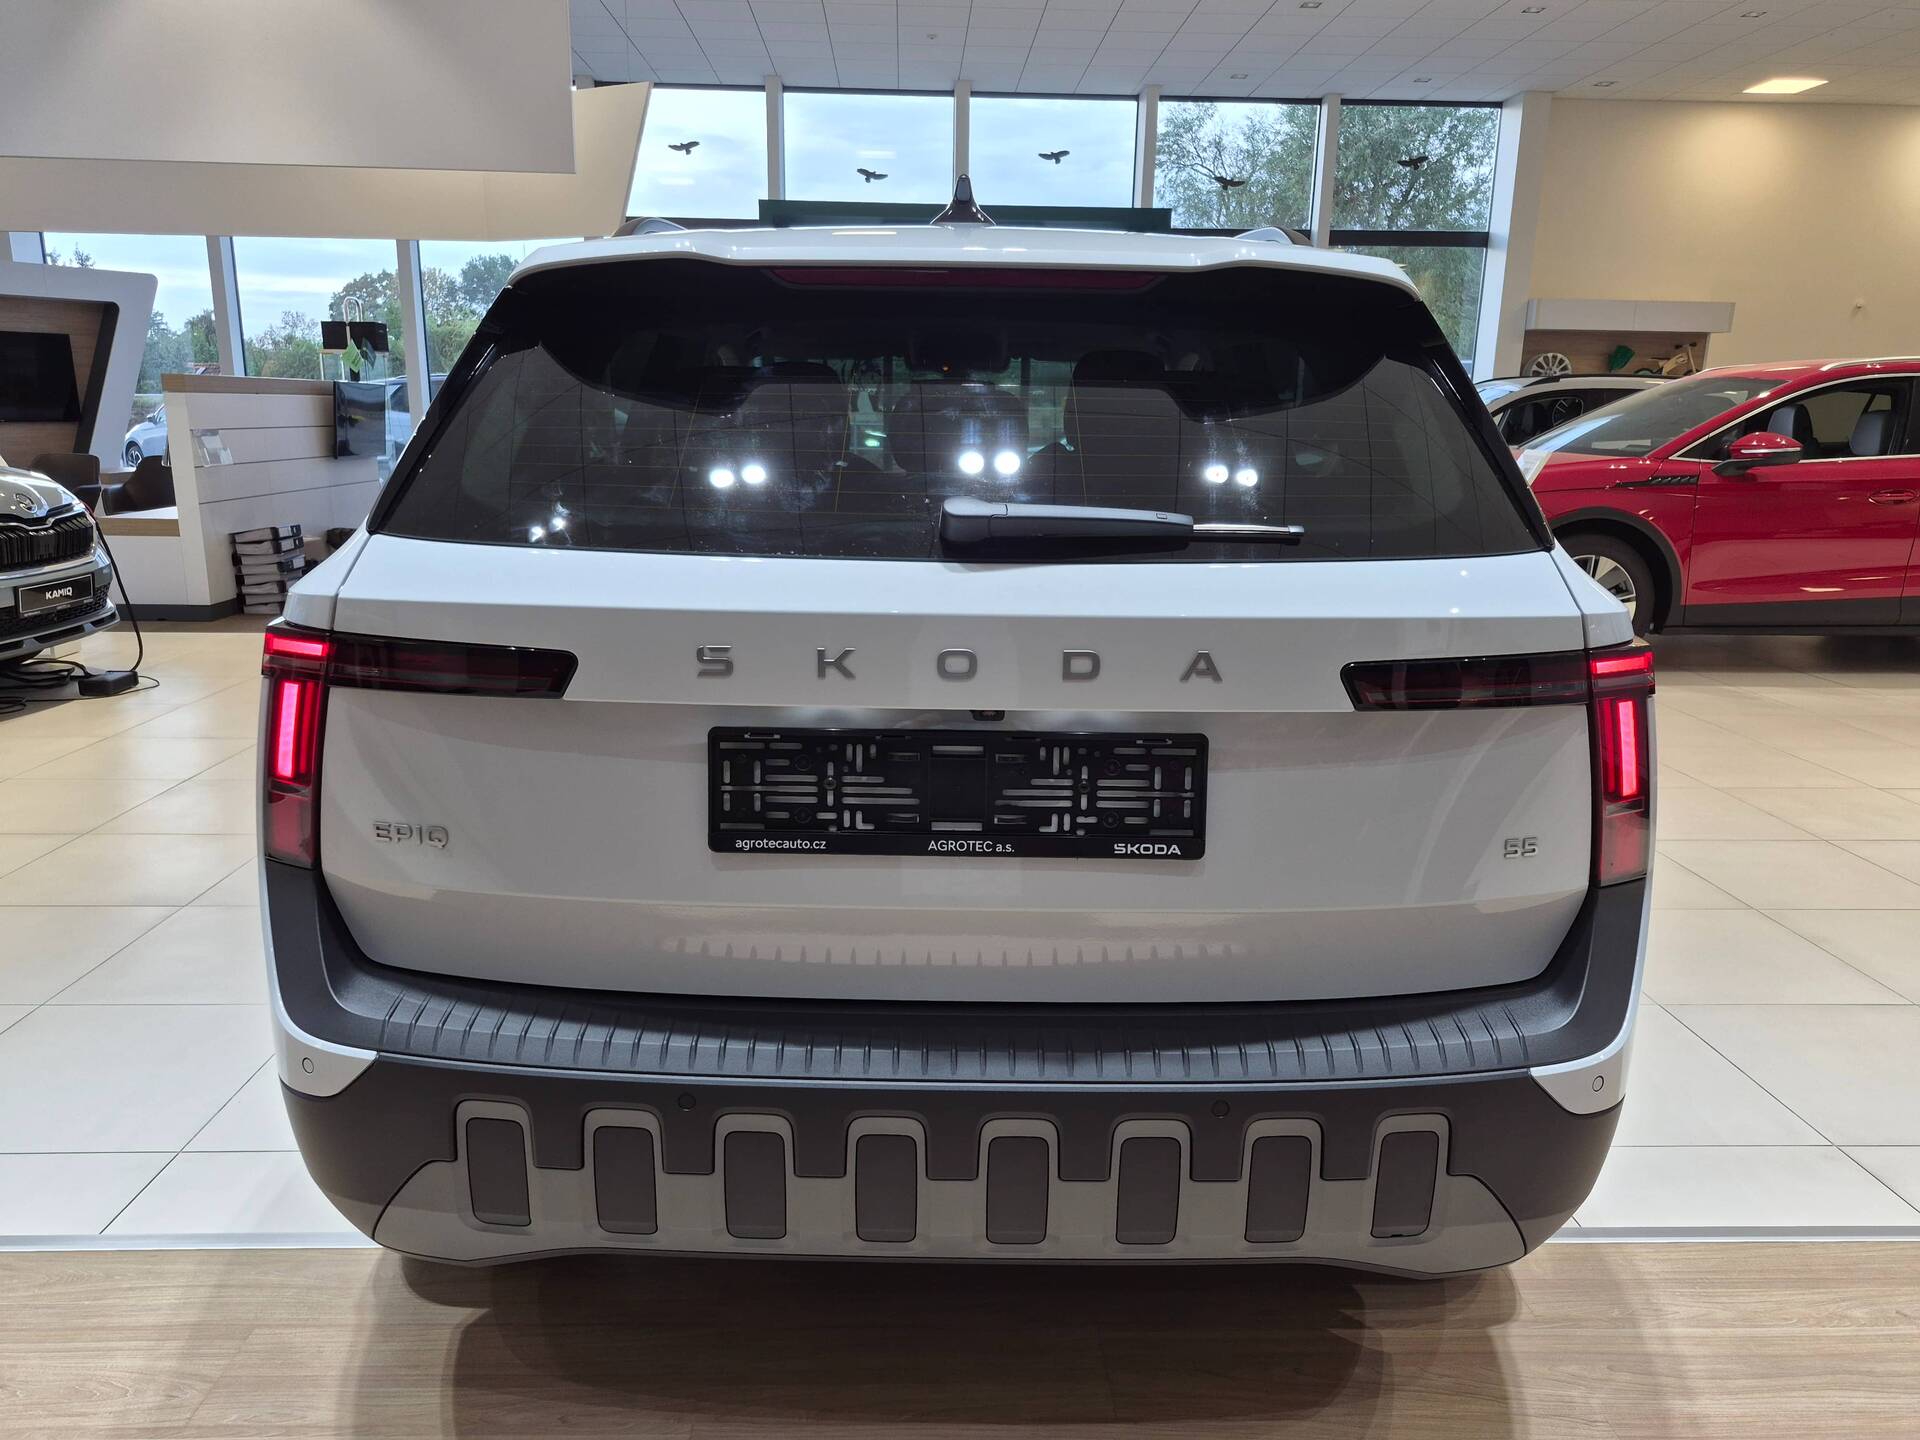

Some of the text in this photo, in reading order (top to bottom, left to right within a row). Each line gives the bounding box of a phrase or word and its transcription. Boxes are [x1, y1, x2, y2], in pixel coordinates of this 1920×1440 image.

[45, 586, 73, 600] KAMIQ
[373, 821, 449, 849] EPIQ
[735, 837, 827, 850] agrotecauto.cz
[928, 840, 1015, 853] AGROTEC a.s.
[1503, 836, 1537, 859] 55
